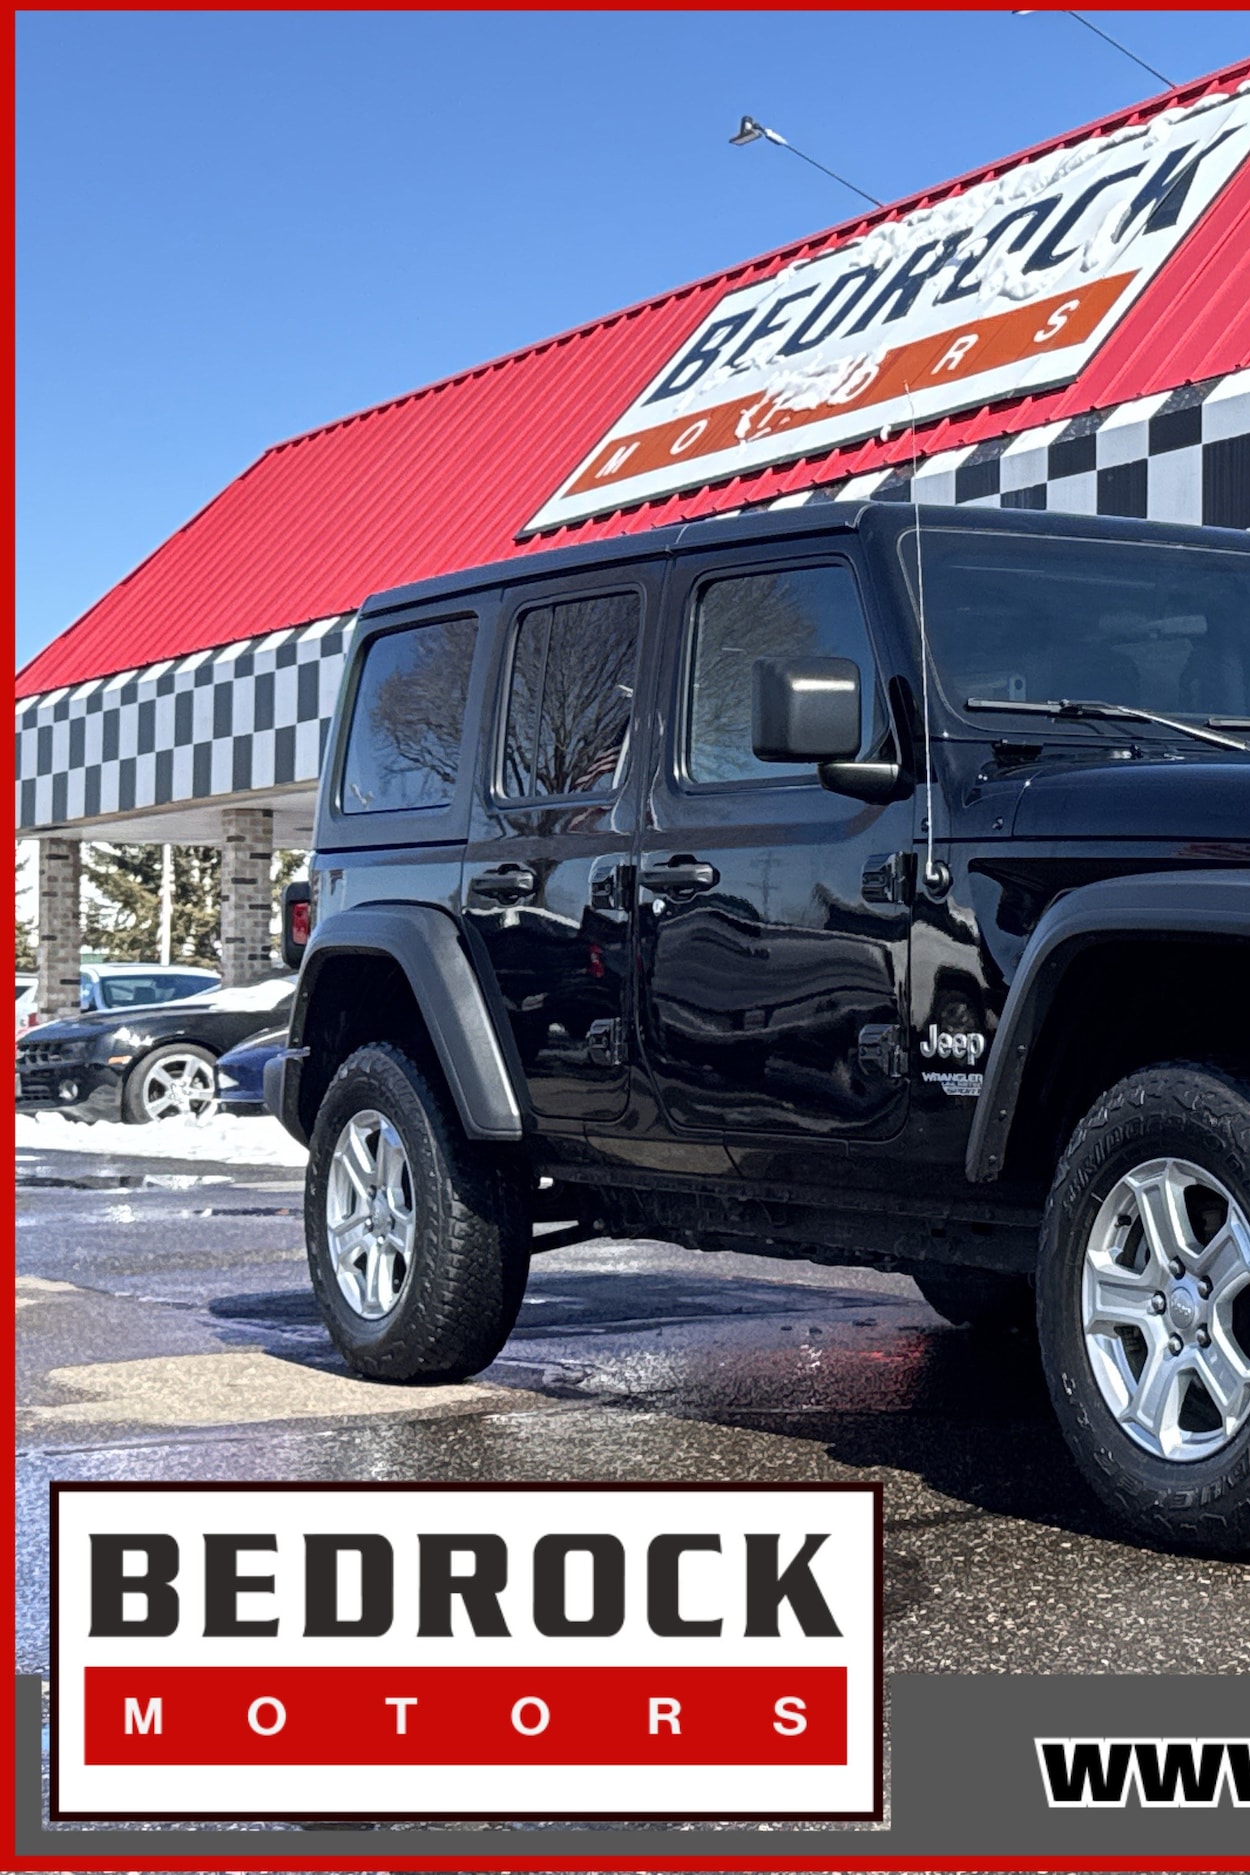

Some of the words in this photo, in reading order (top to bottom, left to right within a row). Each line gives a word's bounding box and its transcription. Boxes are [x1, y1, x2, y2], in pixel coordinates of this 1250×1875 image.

[641, 124, 1246, 406] BEDROCK
[920, 1024, 985, 1066] Jeep
[921, 1072, 983, 1085] WRANGLER
